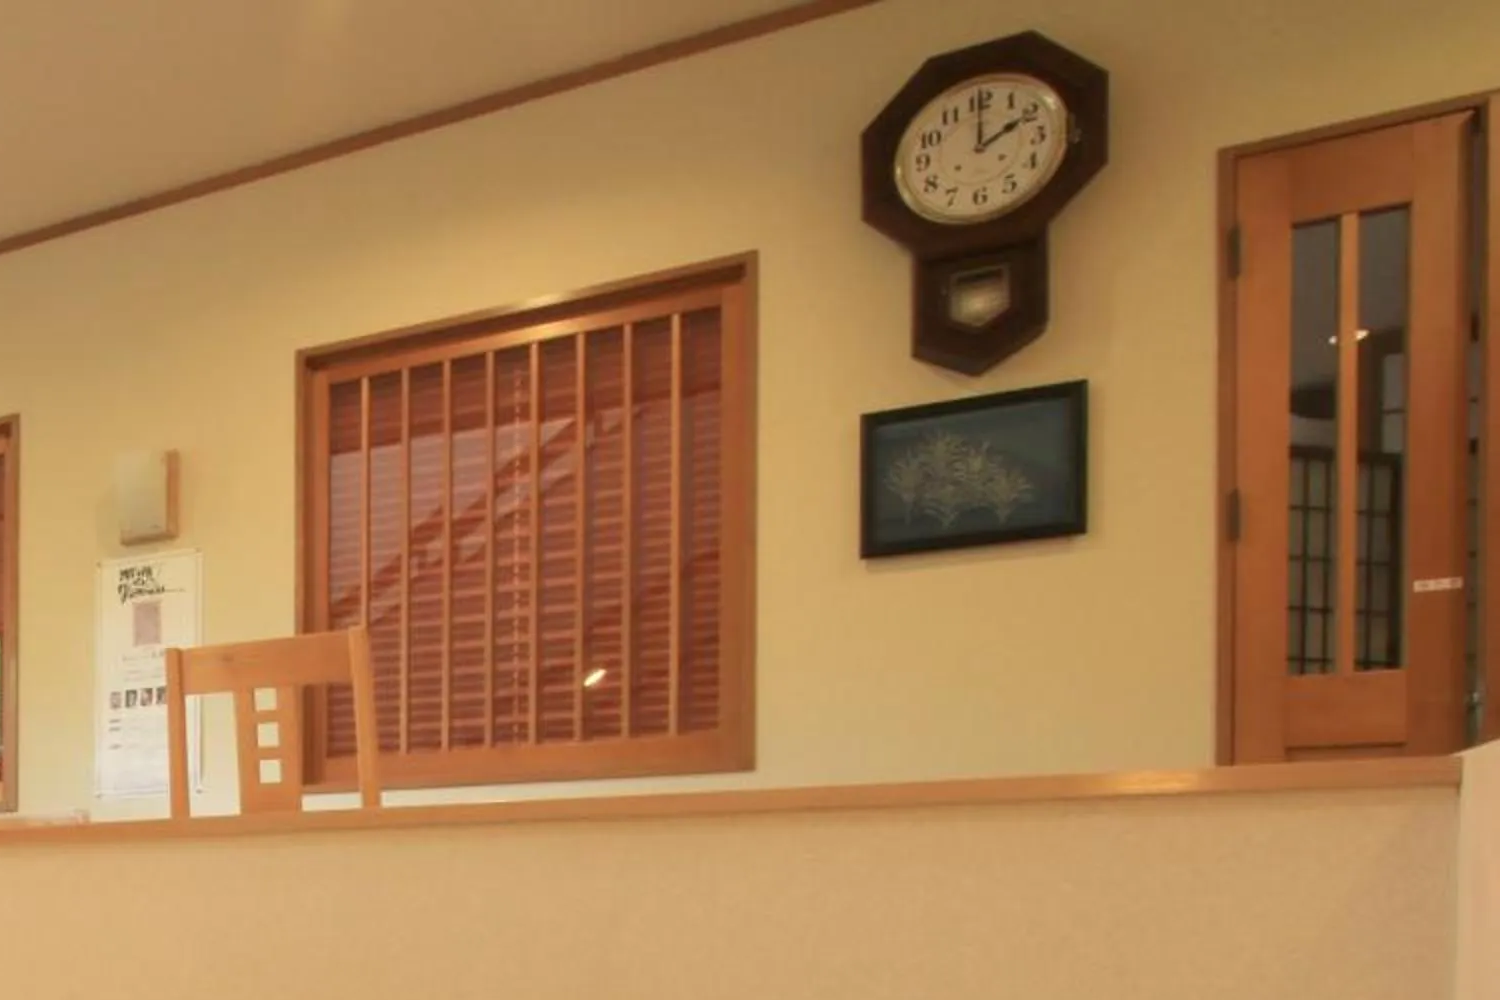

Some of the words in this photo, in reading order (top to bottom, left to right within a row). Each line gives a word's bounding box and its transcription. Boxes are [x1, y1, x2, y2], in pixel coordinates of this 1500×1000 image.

[969, 91, 993, 112] 12
[1008, 92, 1015, 110] 1
[942, 106, 959, 125] 11
[1022, 102, 1039, 124] 2
[921, 130, 941, 149] 10
[1030, 125, 1046, 145] 3
[915, 154, 931, 172] 9
[1021, 152, 1037, 169] 4
[924, 175, 938, 193] 8
[1002, 173, 1017, 193] 5
[945, 187, 959, 207] 7
[972, 186, 989, 205] 6
